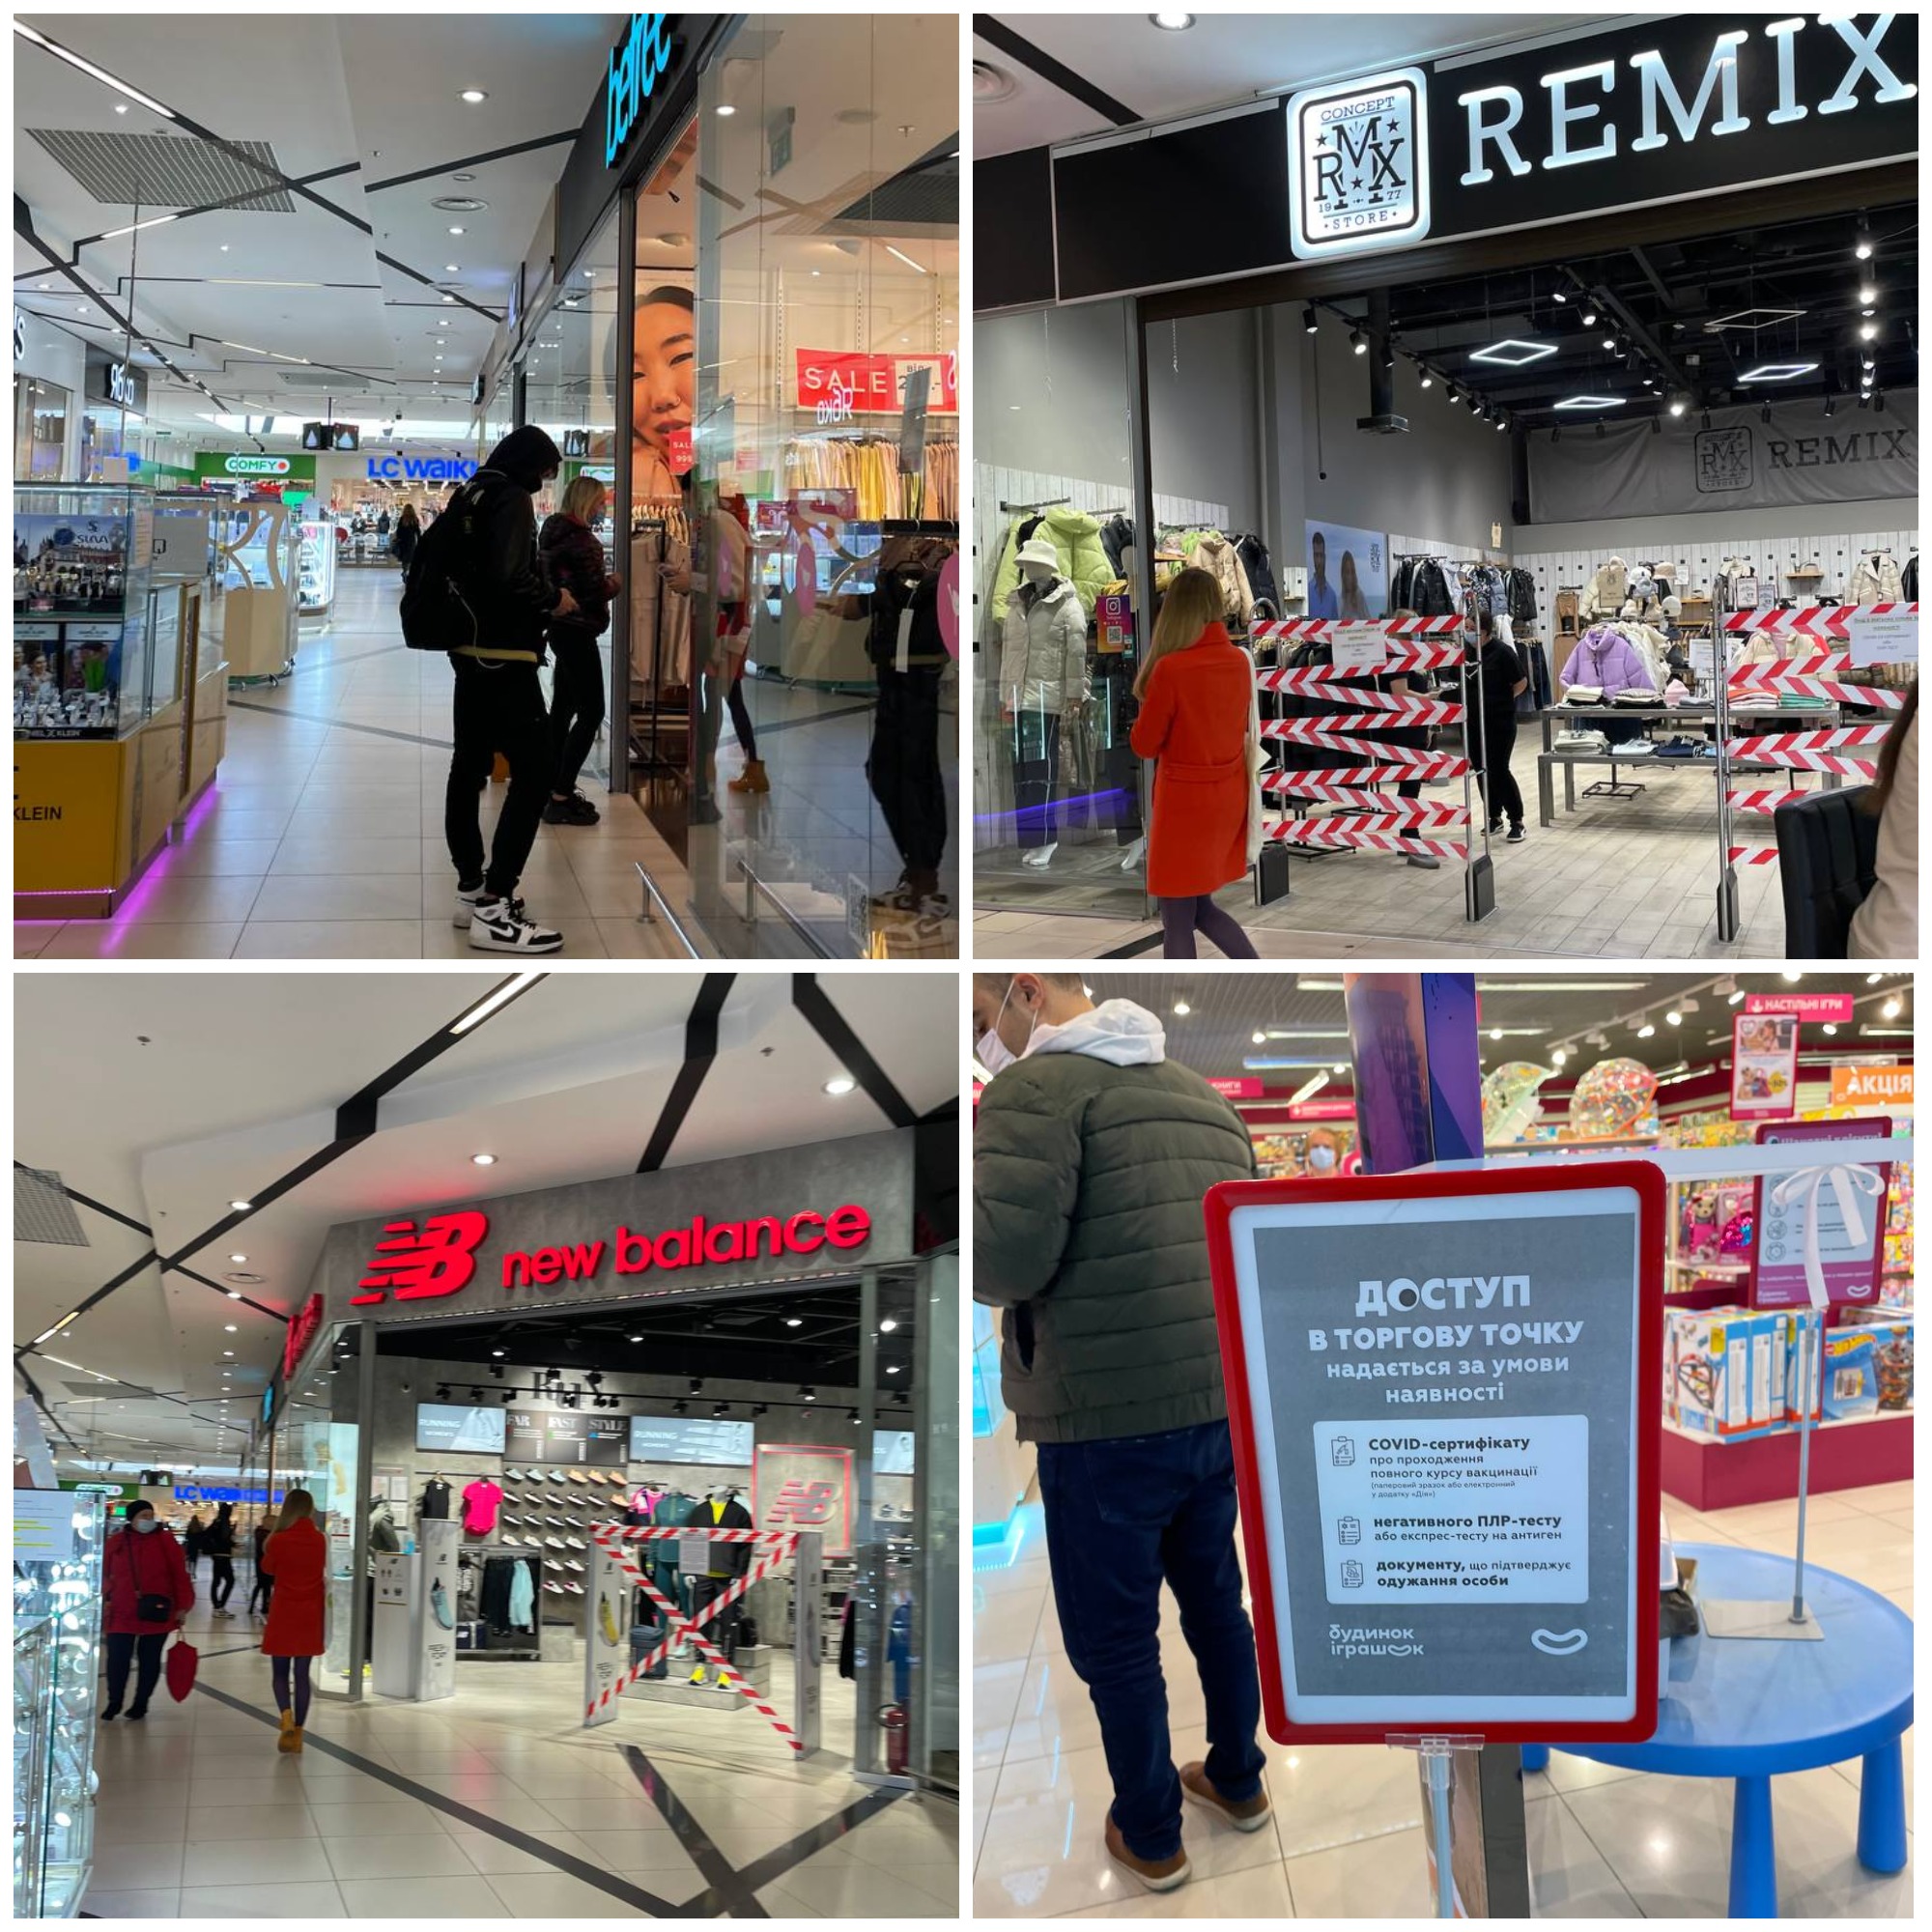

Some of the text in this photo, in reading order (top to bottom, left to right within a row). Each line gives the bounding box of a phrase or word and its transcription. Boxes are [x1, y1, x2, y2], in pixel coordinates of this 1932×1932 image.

[1321, 96, 1396, 122] CONCEPT
[1457, 14, 1918, 186] REMIX
[1332, 210, 1389, 231] STORE
[804, 366, 889, 394] SALE
[672, 440, 694, 449] SAL
[1767, 428, 1912, 469] REMIX
[228, 459, 277, 471] COMFY
[367, 457, 401, 478] LC
[14, 806, 63, 821] KLEIN
[1846, 1073, 1913, 1096] АКЦІЯ
[501, 1238, 607, 1290] new
[614, 1204, 872, 1276] balance
[1354, 1274, 1532, 1318] ДОСТУП
[1308, 1321, 1585, 1351] В ТОРГОВУ ТОЧКУ
[1326, 1356, 1570, 1380] надається за умови
[1385, 1381, 1505, 1404] наявності
[1368, 1435, 1531, 1454] COVID-сертифікату
[1369, 1454, 1484, 1465] про проходження
[1370, 1464, 1539, 1481] повного курсу вакцинації
[1371, 1480, 1516, 1491] (паперовий зразок або електронний
[1374, 1515, 1562, 1529] негативного ПЛР-тесту
[1374, 1530, 1562, 1543] або експрес-тесту на антиген
[1376, 1559, 1572, 1573] документу, що підтверджує
[1377, 1575, 1510, 1589] одужання особи
[1328, 1623, 1415, 1643] будинок
[1331, 1640, 1425, 1660] іграшок
